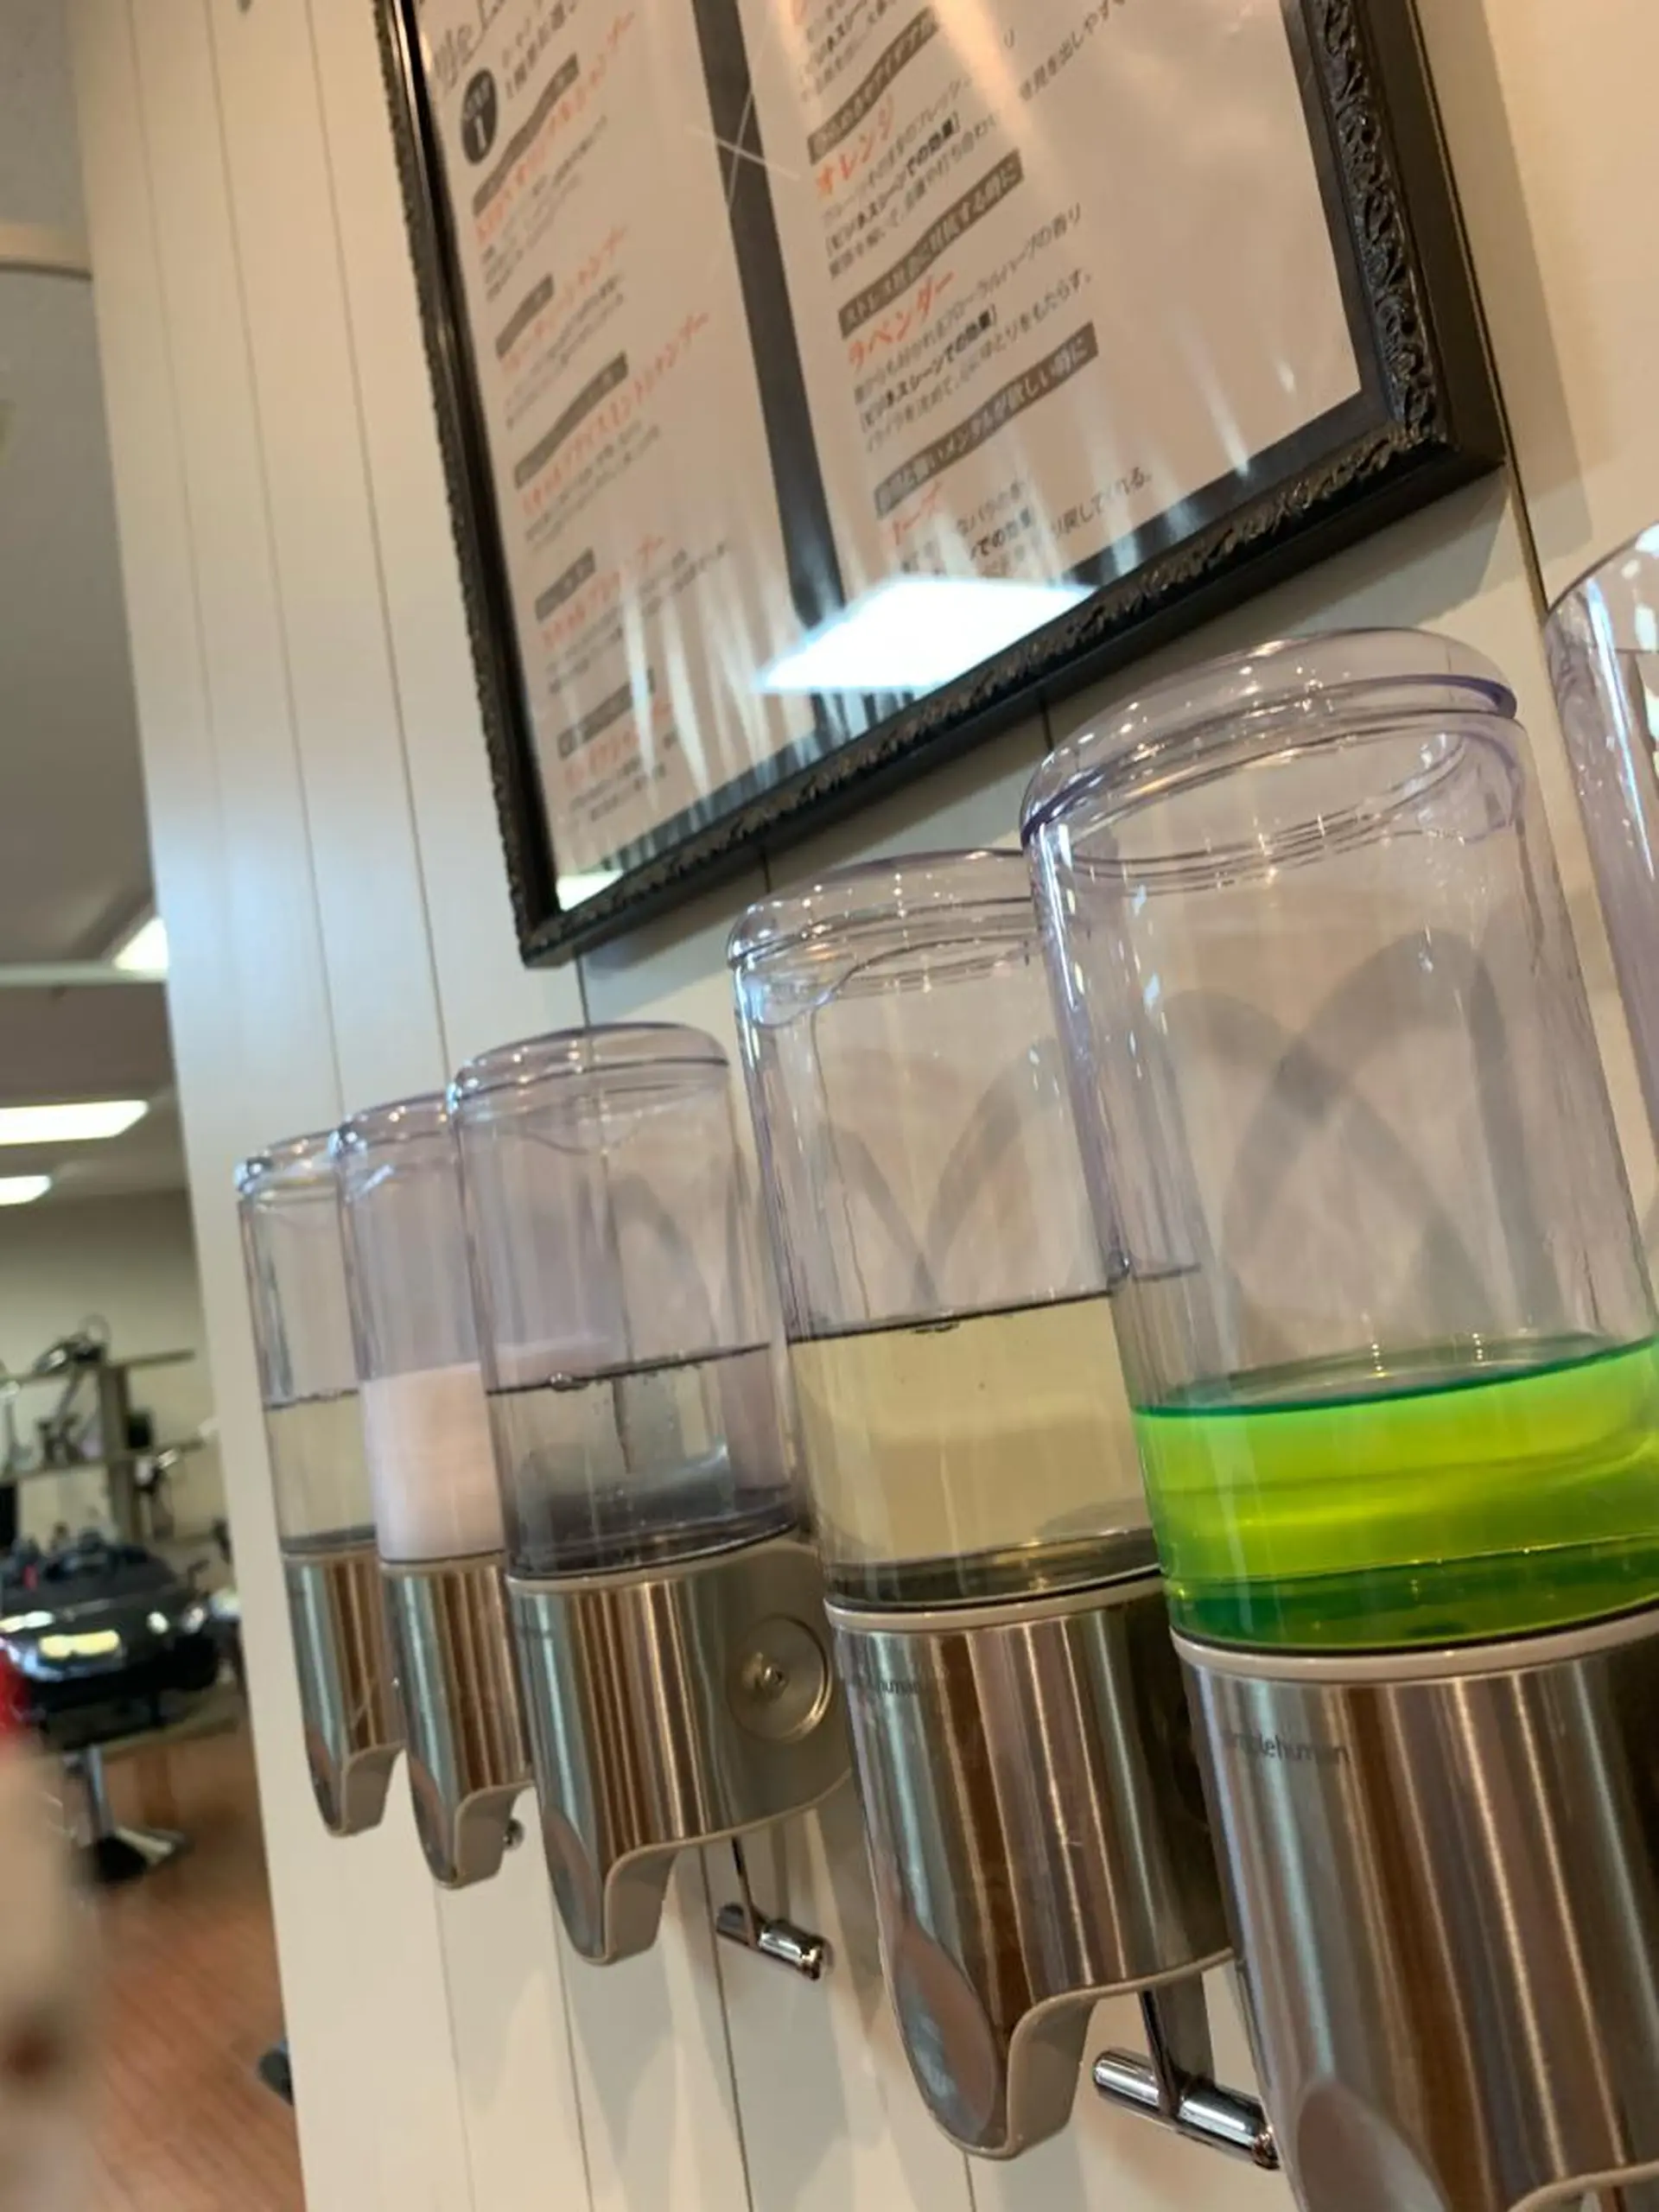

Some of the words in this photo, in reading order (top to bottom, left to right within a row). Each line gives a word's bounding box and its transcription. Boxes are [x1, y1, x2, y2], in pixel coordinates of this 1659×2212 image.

[849, 270, 954, 372] ラベンダー
